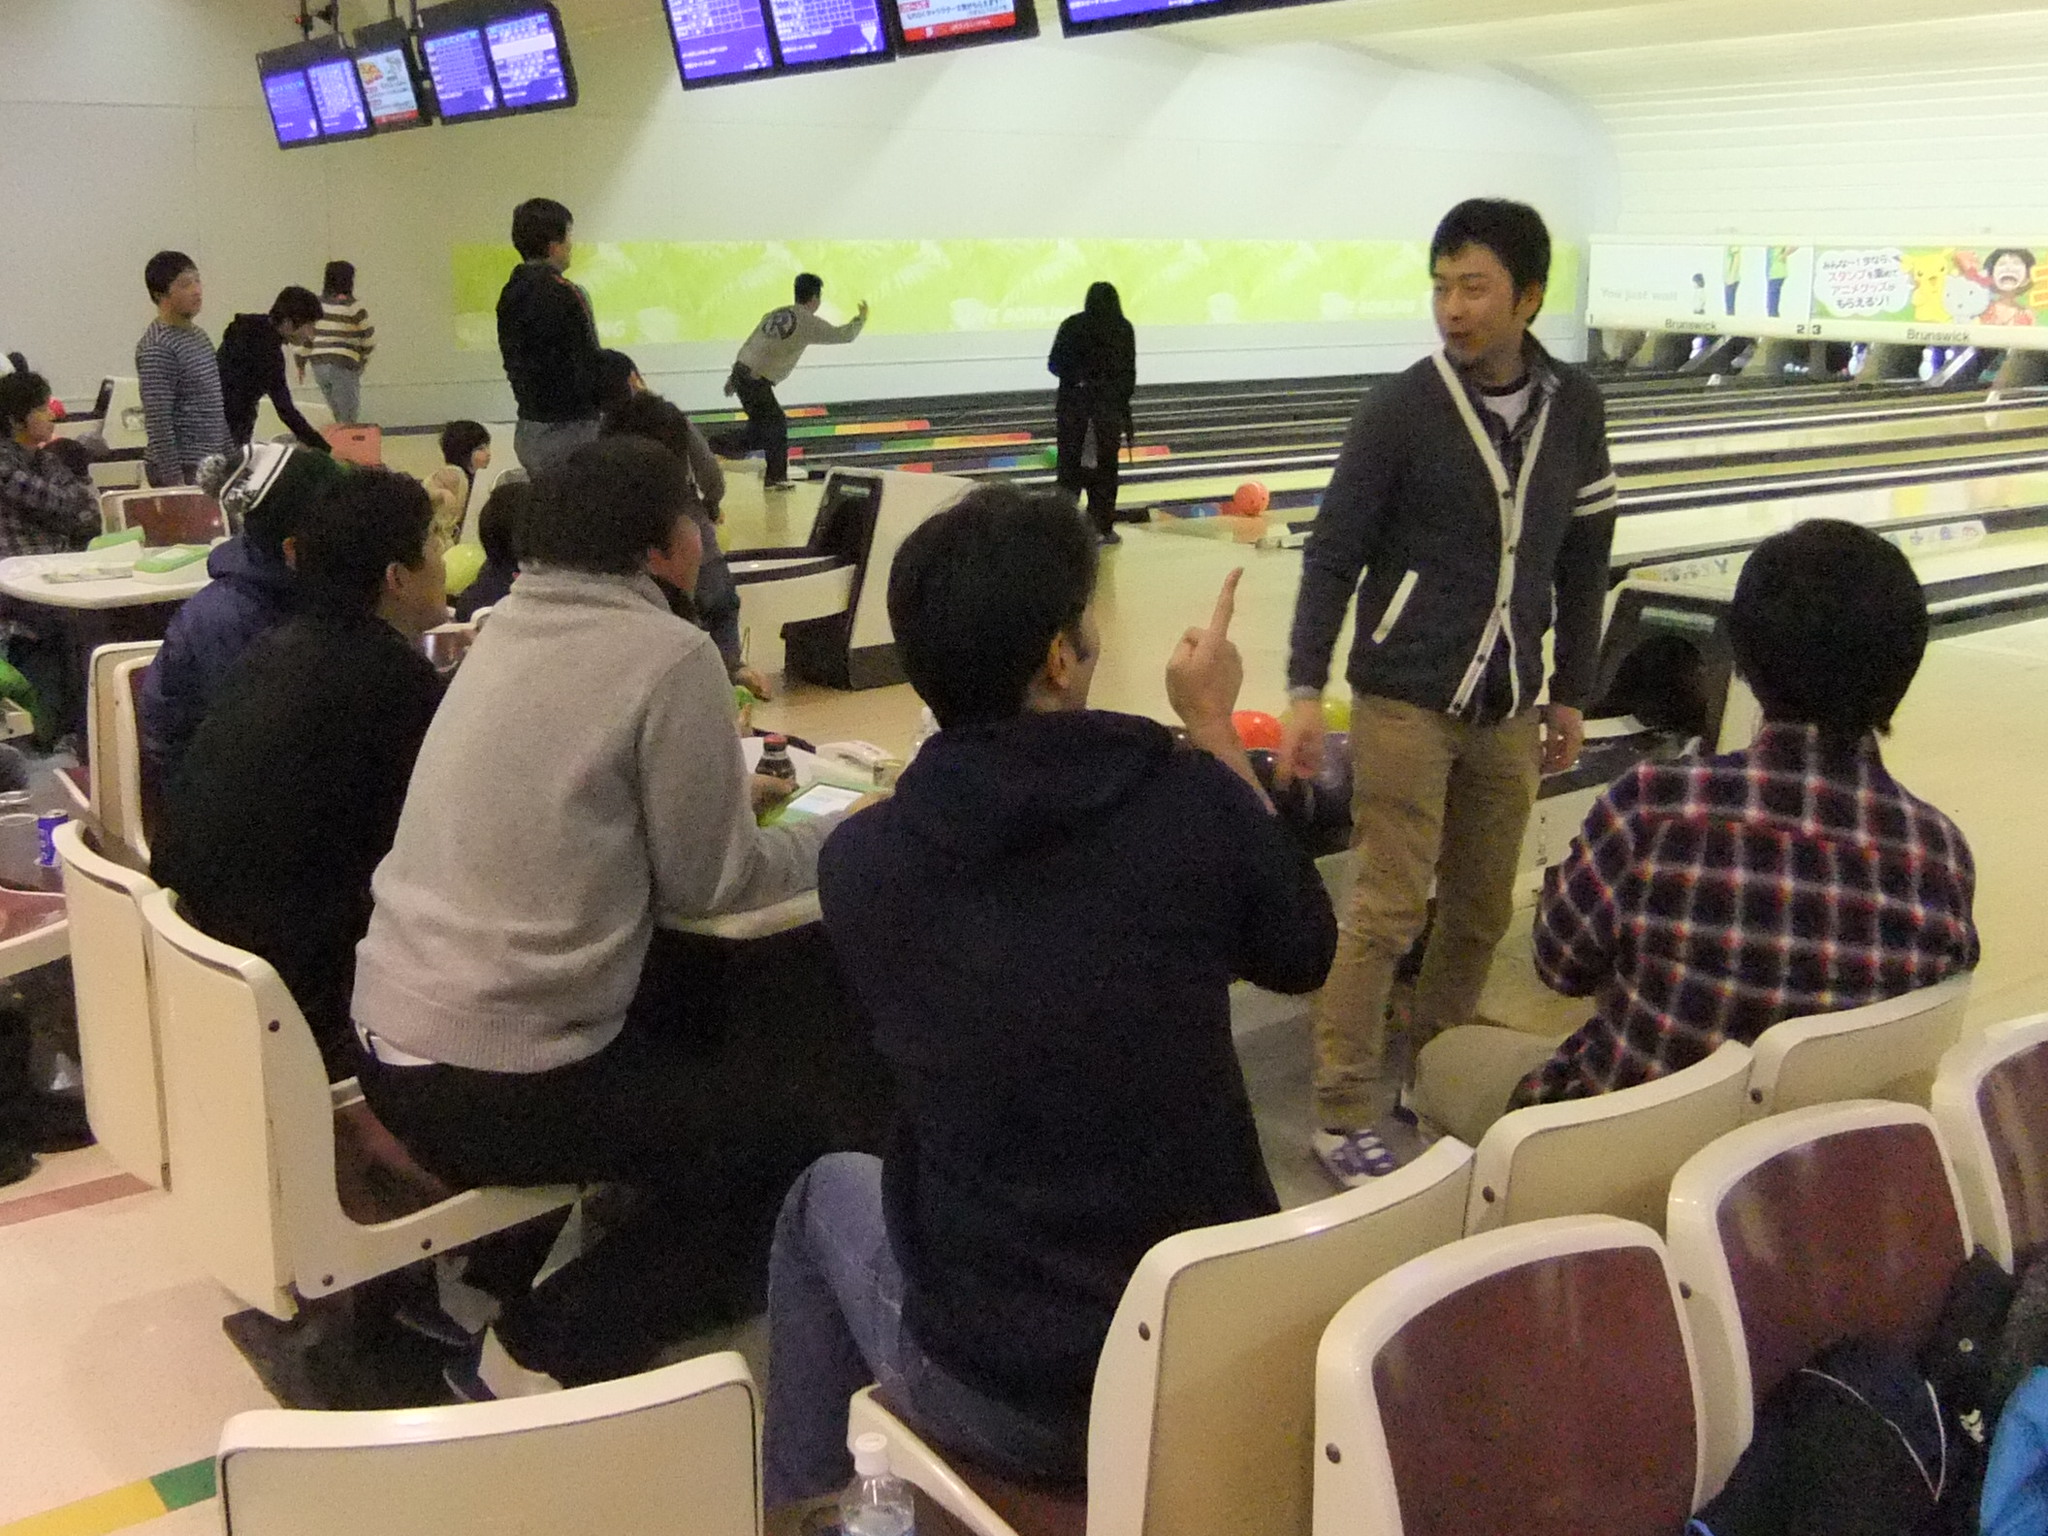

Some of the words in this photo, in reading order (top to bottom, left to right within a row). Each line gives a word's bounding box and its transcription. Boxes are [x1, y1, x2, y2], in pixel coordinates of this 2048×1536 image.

[1664, 318, 1717, 331] Brunswick
[1796, 324, 1805, 335] 2
[1811, 325, 1822, 336] 3
[1906, 328, 1971, 342] Brunswick
